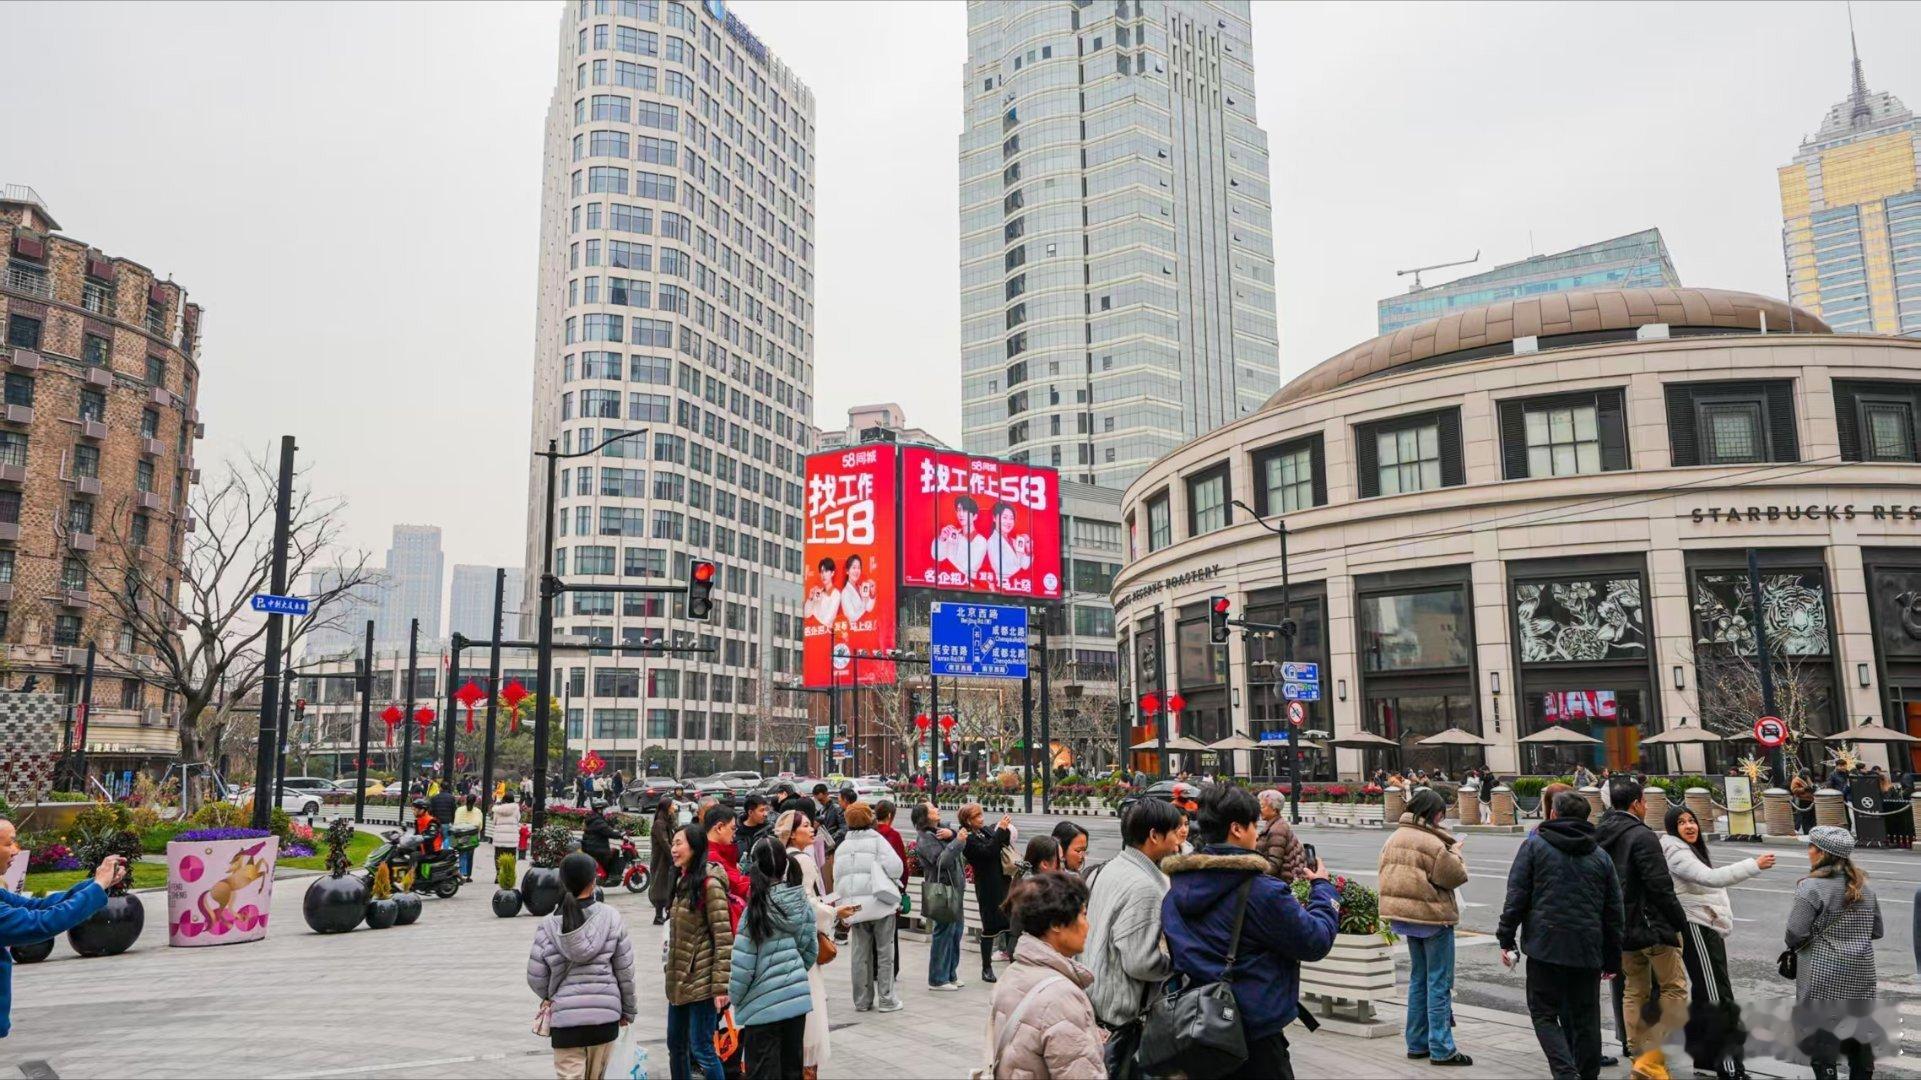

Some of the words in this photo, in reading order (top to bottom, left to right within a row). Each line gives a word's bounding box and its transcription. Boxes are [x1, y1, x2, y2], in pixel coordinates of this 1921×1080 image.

[842, 449, 877, 469] 58同城
[920, 457, 1046, 511] 找工作上58
[808, 472, 874, 518] 找工作
[806, 499, 875, 546] 上58
[1691, 504, 1856, 523] STARBUCKS
[924, 568, 969, 586] 名企招人
[1165, 563, 1220, 590] ROASTERY
[956, 607, 998, 620] 北京西路
[992, 625, 1025, 637] 成都北路
[933, 644, 968, 657] 延安西路
[992, 648, 1026, 659] 成都北路
